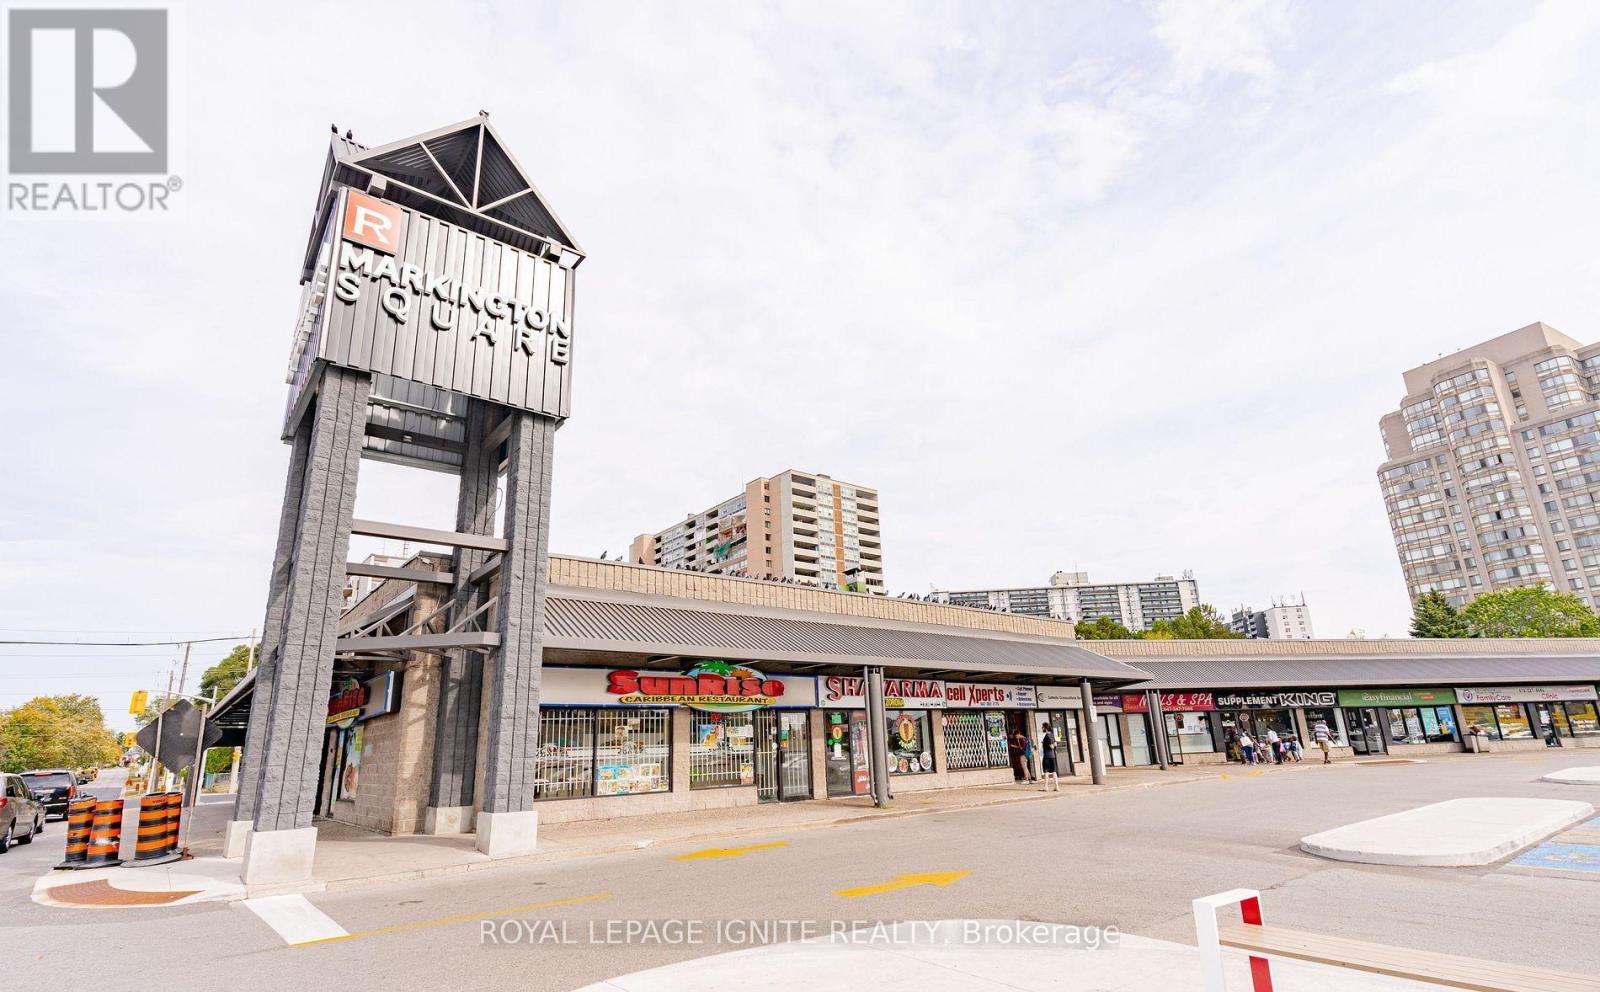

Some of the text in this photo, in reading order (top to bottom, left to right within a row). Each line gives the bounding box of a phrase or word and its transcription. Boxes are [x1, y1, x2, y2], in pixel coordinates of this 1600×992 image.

[352, 206, 393, 243] R
[340, 242, 571, 339] MARKINGTON
[335, 272, 570, 364] SQUARE
[625, 696, 769, 704] CARIBBEAN RESTAURANT
[826, 675, 943, 702] SHARMA
[946, 684, 1005, 706] cell Xperts
[1138, 693, 1174, 707] NLS
[1176, 694, 1187, 706] &
[1189, 692, 1213, 706] SPA
[1217, 692, 1335, 707] SUPPLEMENT KING
